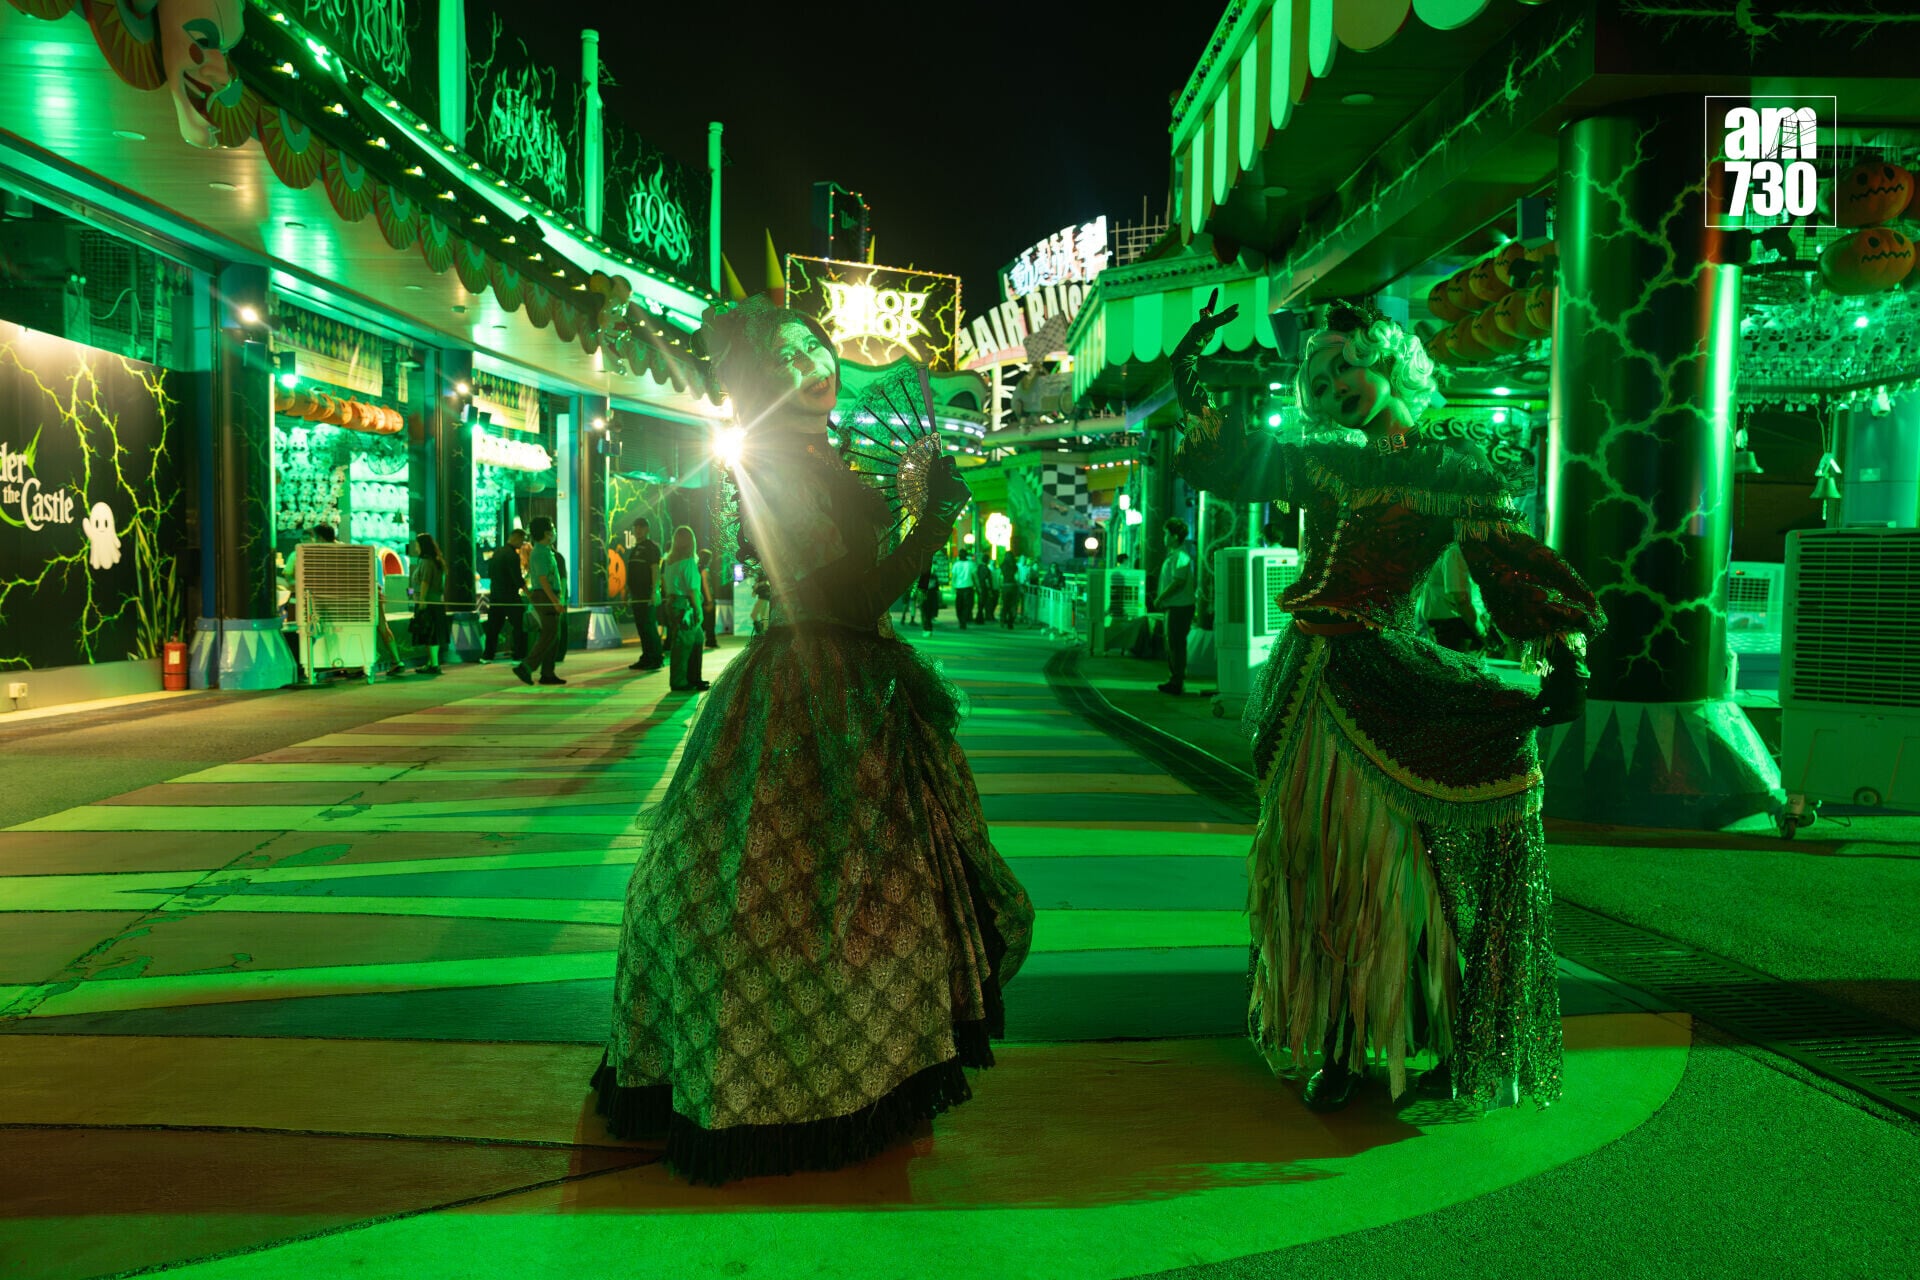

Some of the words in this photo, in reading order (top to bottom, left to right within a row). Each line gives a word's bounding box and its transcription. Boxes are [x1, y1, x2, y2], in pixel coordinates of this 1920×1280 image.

[628, 190, 690, 260] TOSS
[3, 484, 20, 504] the
[21, 477, 74, 531] Castle
